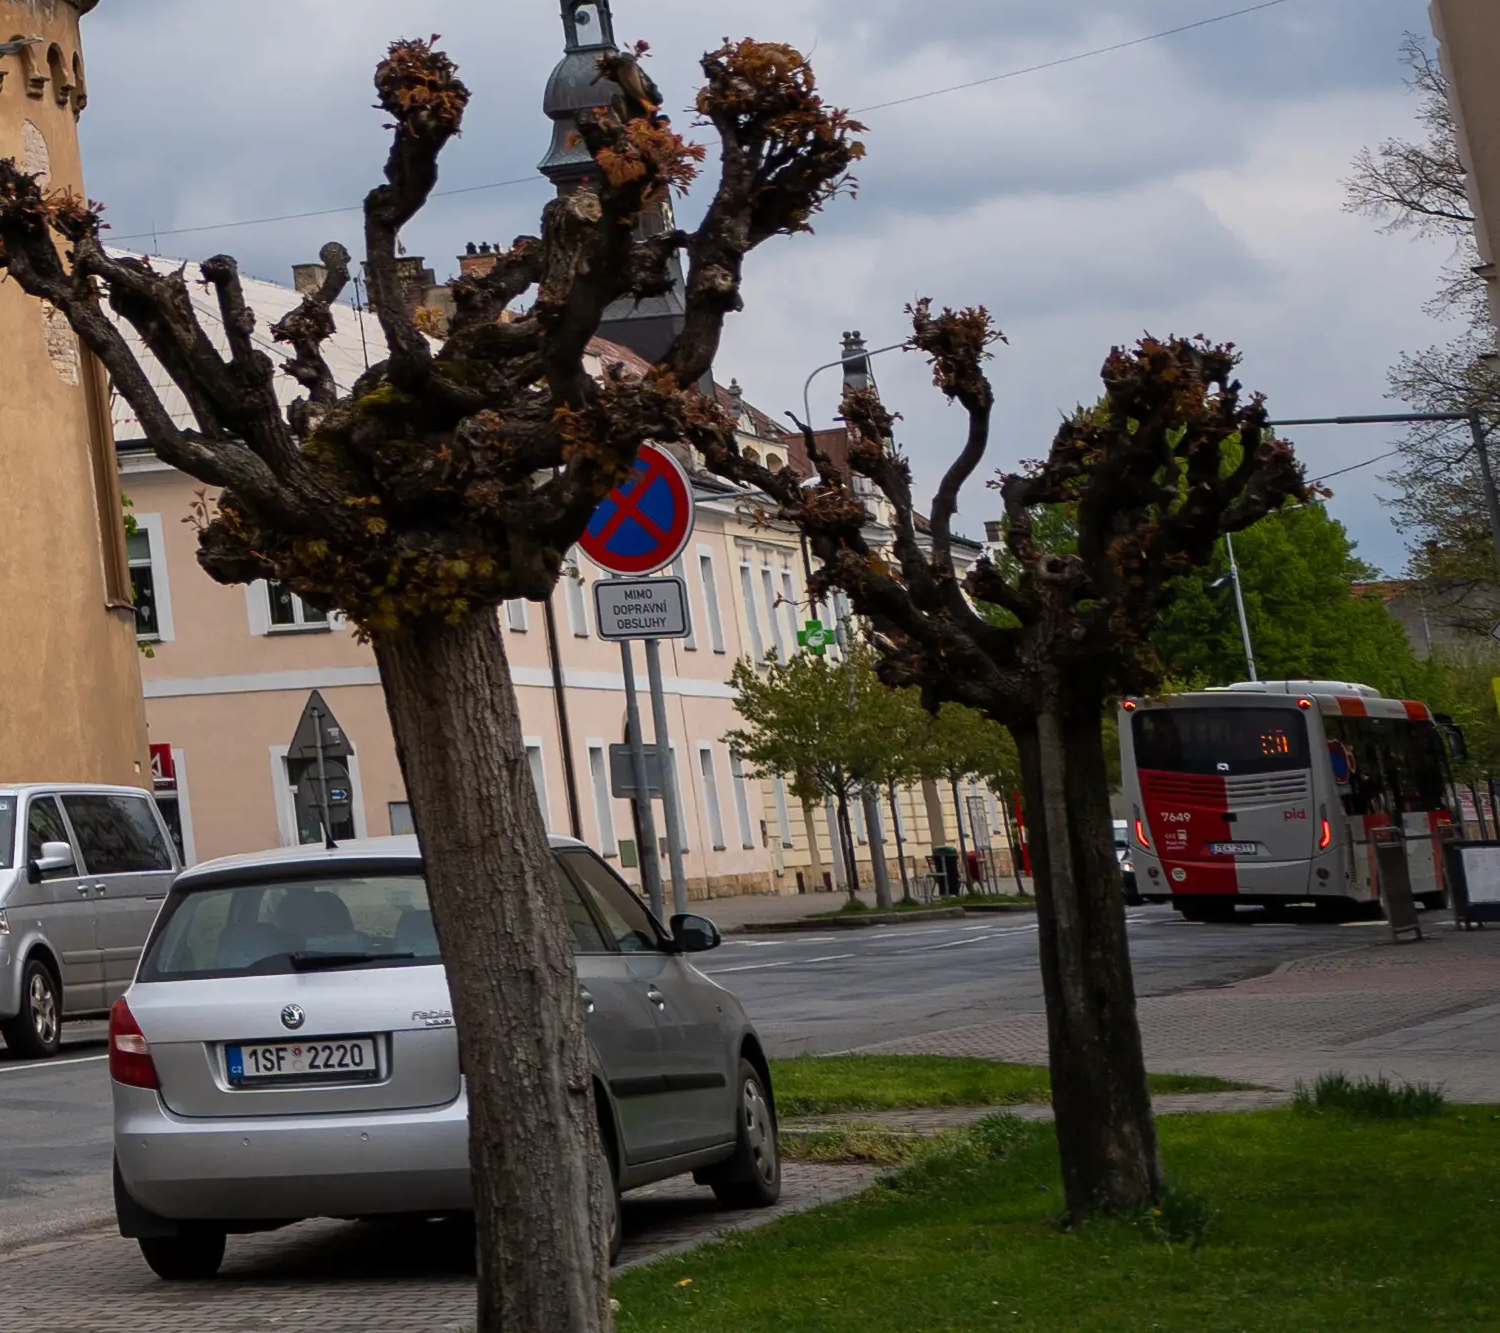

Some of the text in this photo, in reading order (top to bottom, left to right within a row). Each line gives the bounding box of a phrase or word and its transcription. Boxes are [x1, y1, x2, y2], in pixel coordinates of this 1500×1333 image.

[624, 588, 653, 600] MIMO
[612, 599, 668, 615] DOPRAVNÍ
[616, 617, 667, 629] OBSLUHY
[1160, 812, 1191, 822] 7649
[1283, 808, 1306, 823] pid
[249, 1043, 364, 1072] 1SF 2220
